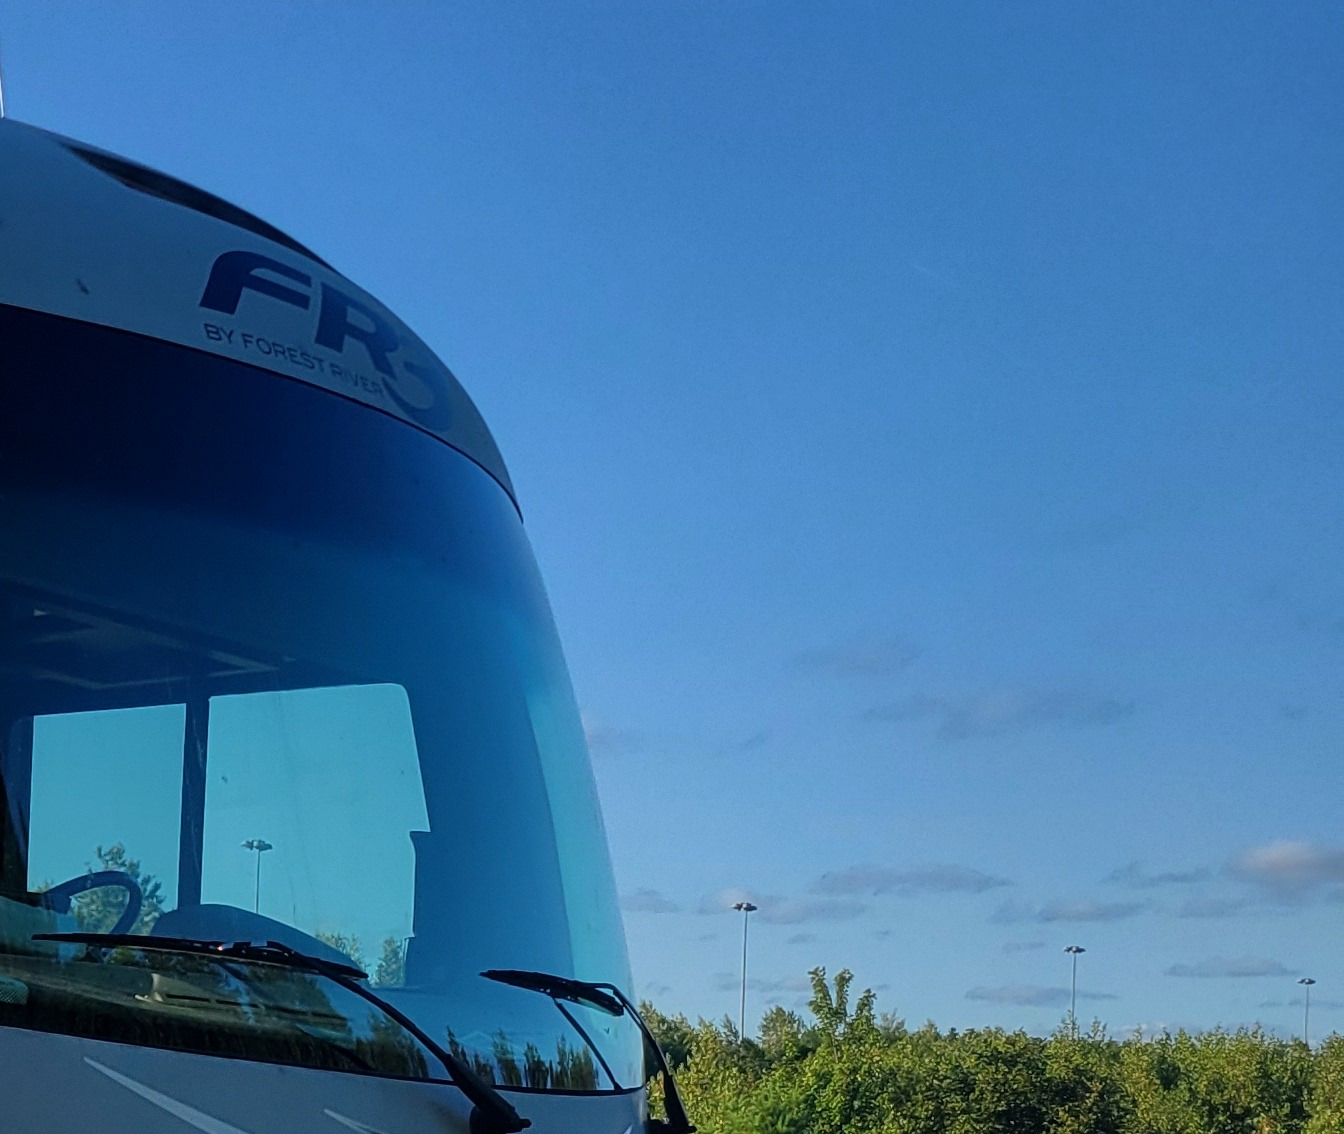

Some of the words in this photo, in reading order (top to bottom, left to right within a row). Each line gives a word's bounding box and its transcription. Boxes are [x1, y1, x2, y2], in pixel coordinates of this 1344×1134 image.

[199, 250, 454, 432] FR3
[203, 322, 235, 344] BY
[242, 332, 326, 374] FOREST
[331, 363, 386, 396] RIVER
